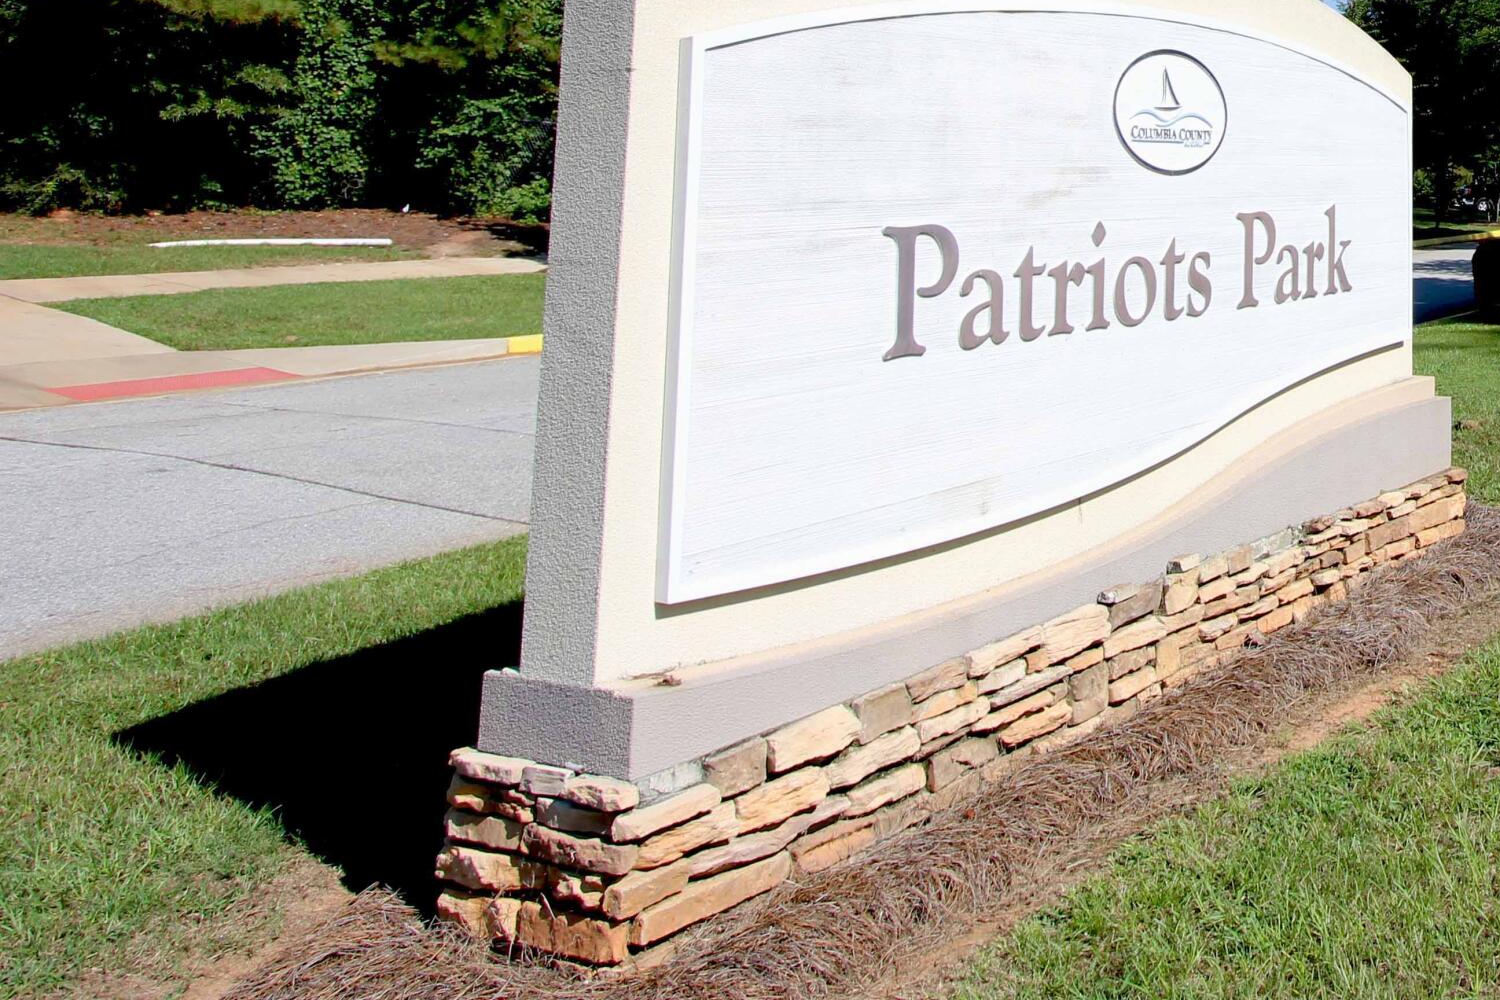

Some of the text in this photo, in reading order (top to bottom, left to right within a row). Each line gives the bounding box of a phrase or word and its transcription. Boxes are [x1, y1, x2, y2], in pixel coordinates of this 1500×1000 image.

[1131, 125, 1212, 142] COLUMBIA COUNTY
[882, 205, 1353, 362] Patriots Park
